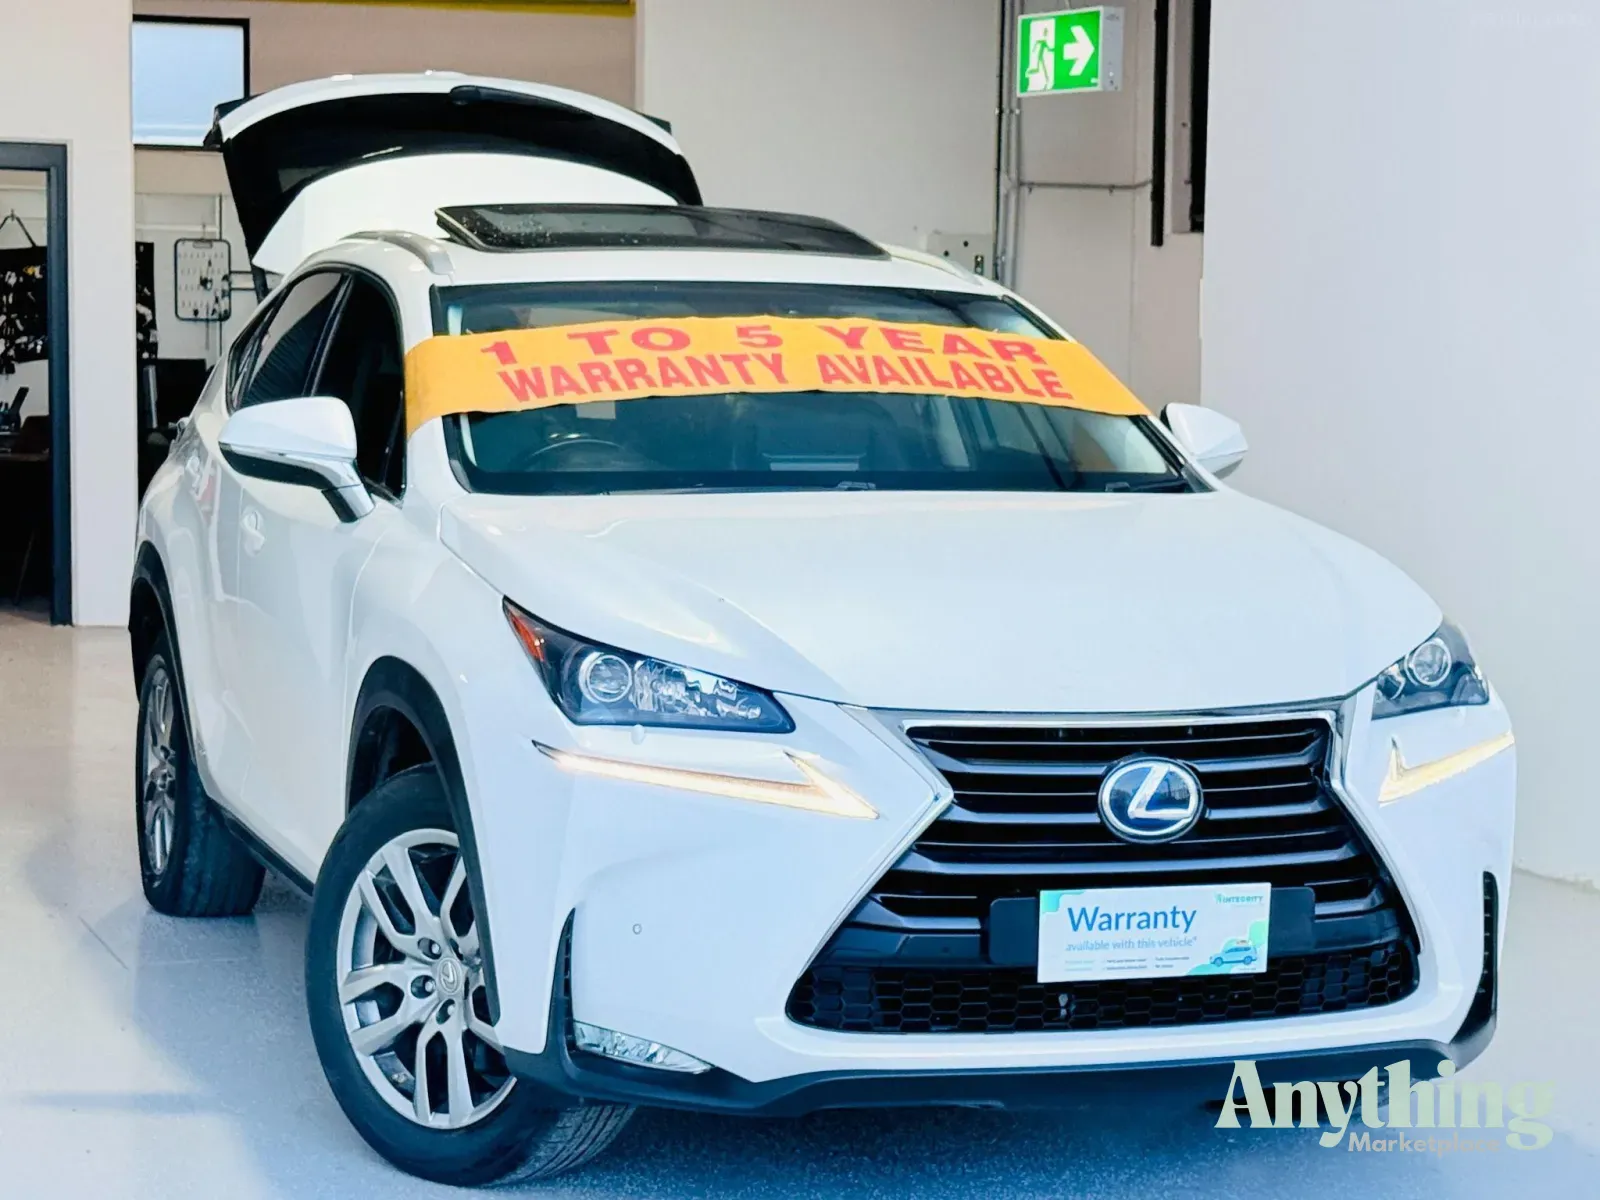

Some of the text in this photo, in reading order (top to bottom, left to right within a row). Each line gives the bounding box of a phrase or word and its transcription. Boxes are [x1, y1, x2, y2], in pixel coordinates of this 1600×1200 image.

[481, 325, 1049, 365] 1 TO 5 YEAR
[497, 352, 1074, 402] WARRANTY AVAILABLE
[1067, 905, 1197, 934] Warranty
[1066, 938, 1110, 952] available
[1112, 939, 1135, 949] with
[1137, 937, 1156, 949] this
